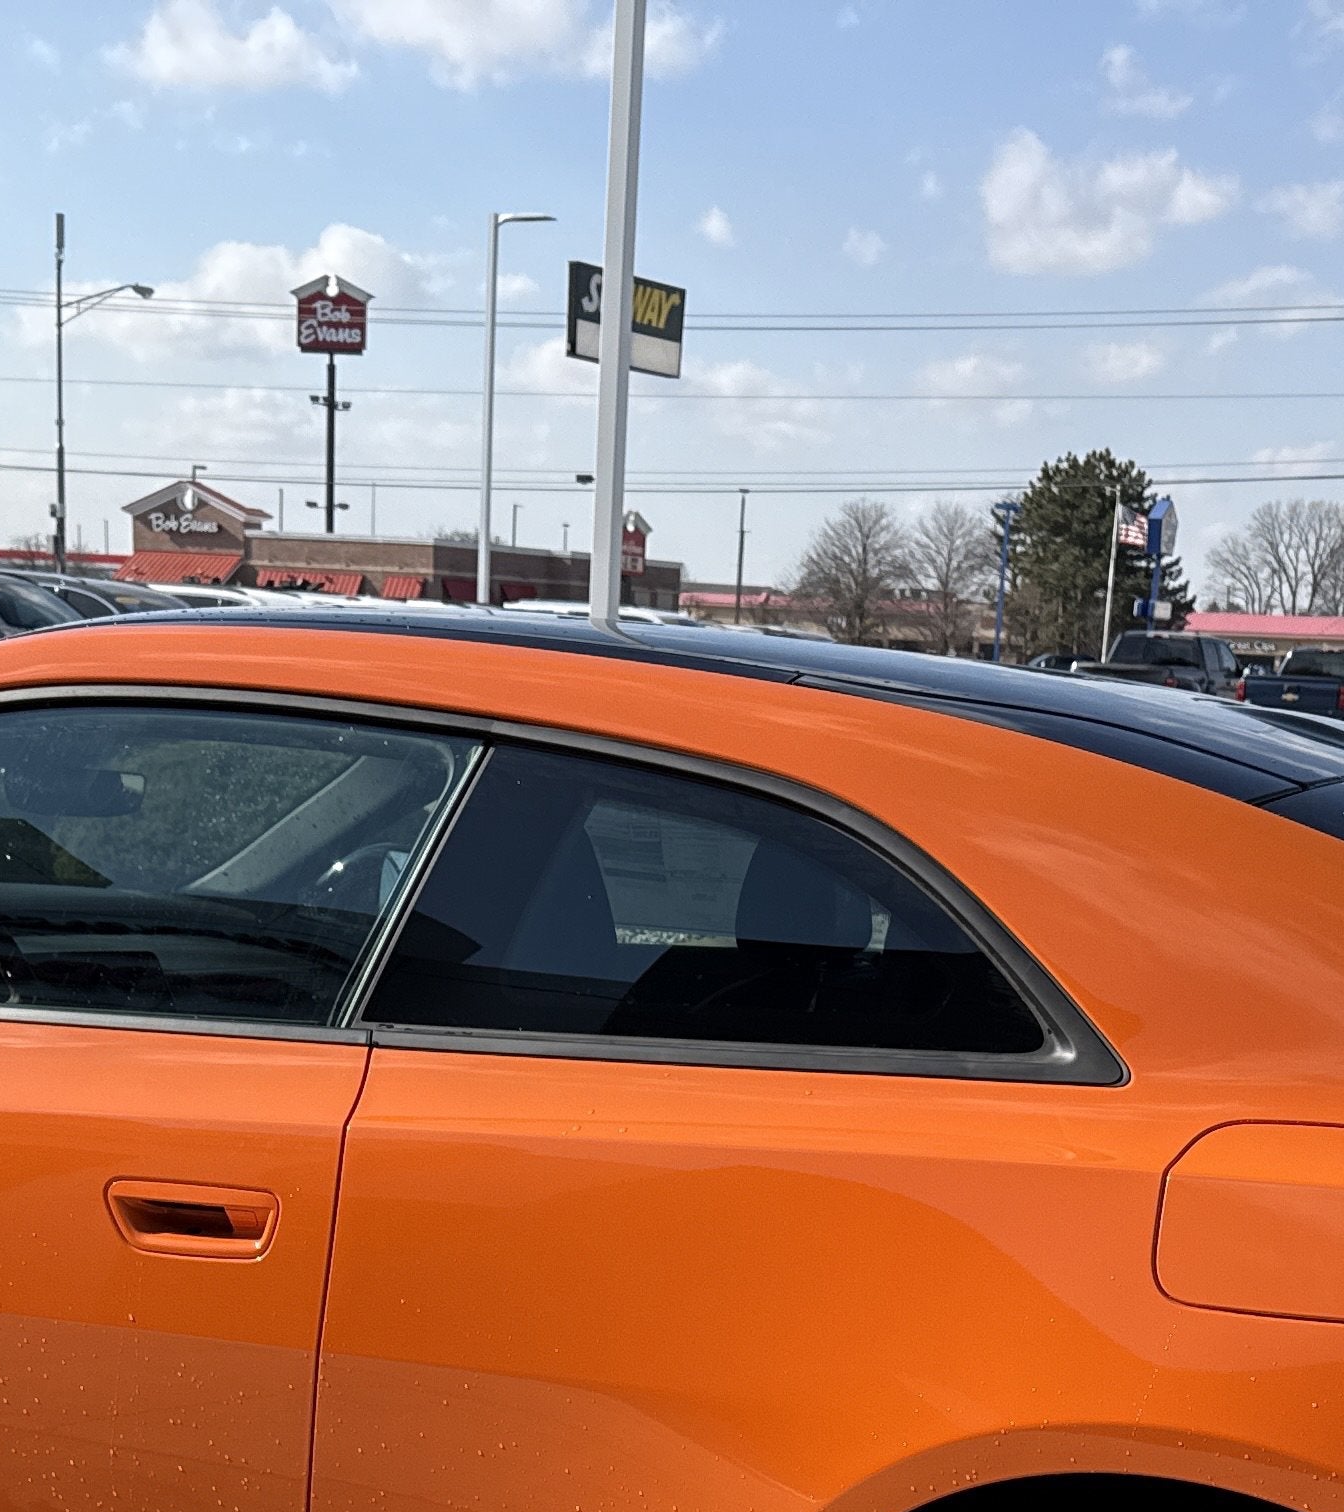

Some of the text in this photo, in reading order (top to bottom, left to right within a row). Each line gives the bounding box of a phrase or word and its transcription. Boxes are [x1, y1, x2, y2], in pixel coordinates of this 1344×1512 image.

[312, 300, 352, 323] Bob
[581, 273, 682, 330] SWAY
[299, 318, 362, 344] Evans
[149, 512, 219, 533] Bob Evans
